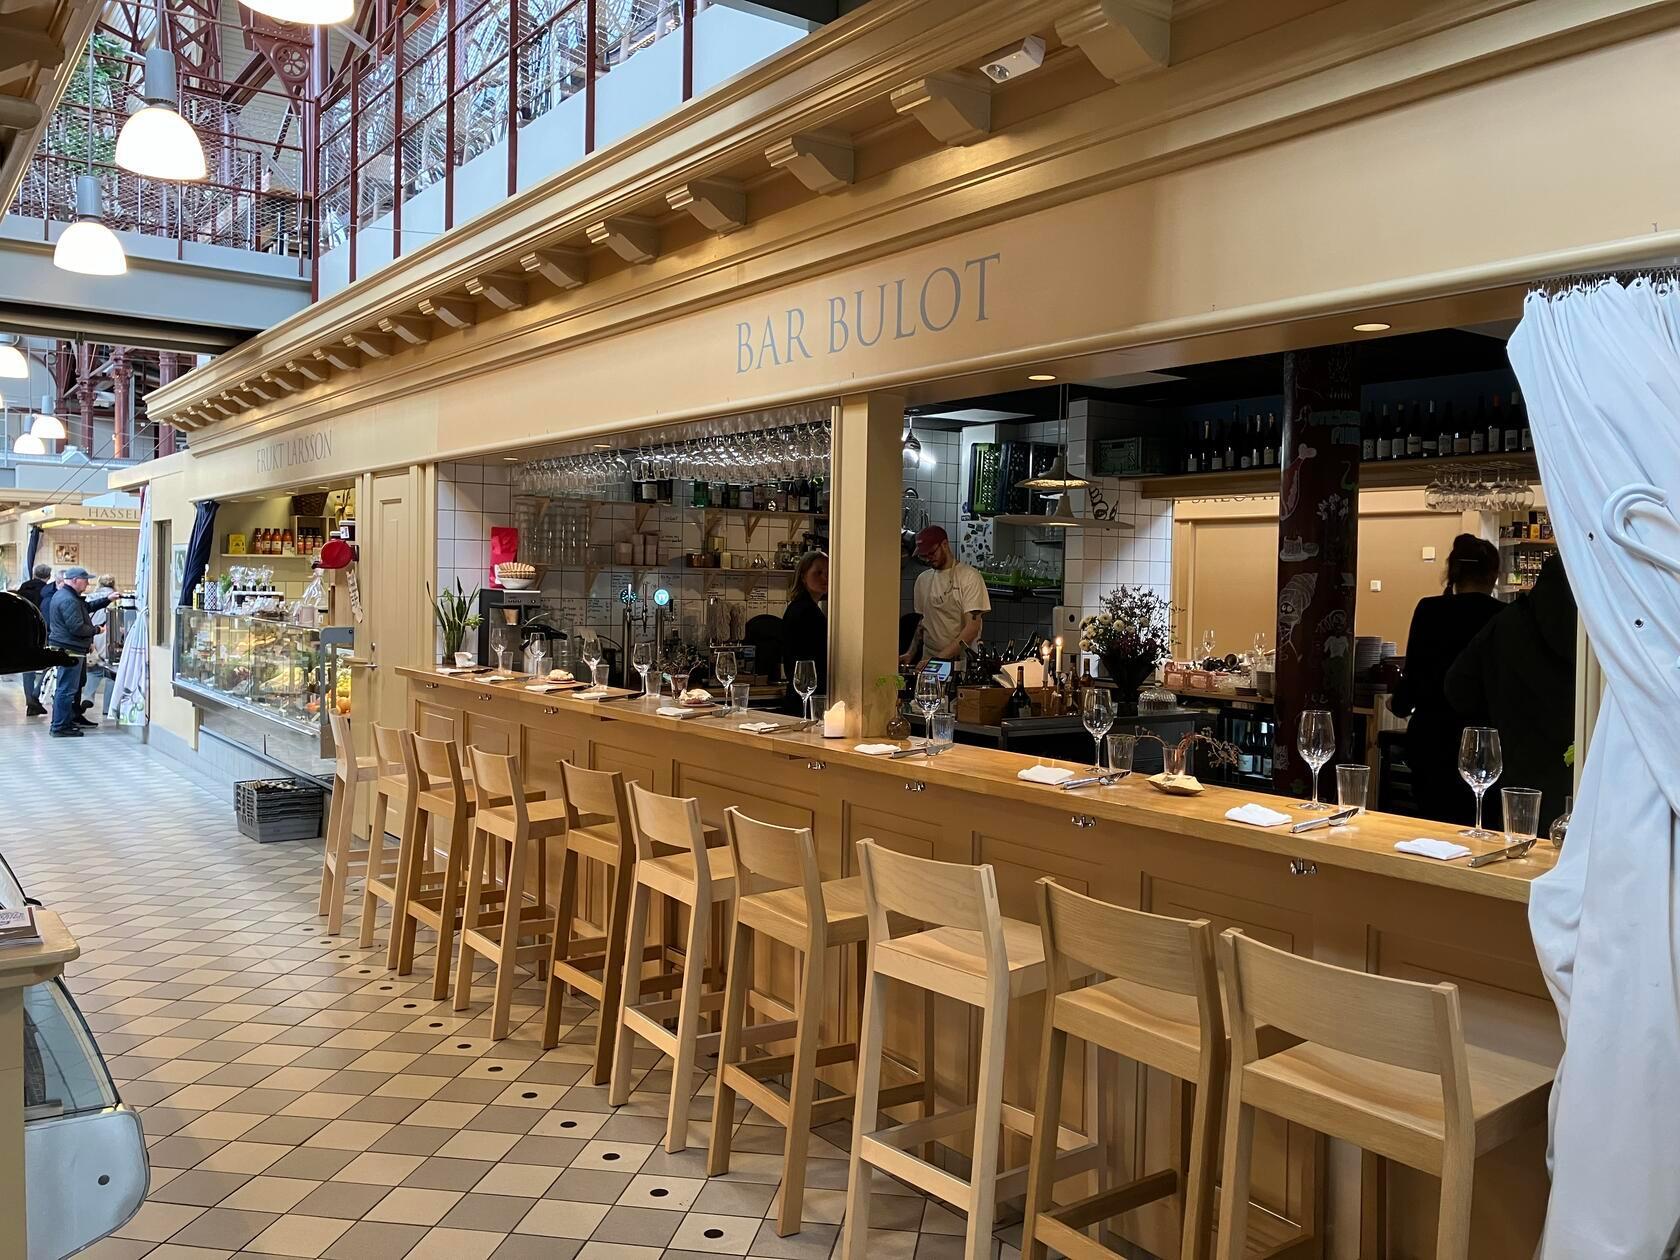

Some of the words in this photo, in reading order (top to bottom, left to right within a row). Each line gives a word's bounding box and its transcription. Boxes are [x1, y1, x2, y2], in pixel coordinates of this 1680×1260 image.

[736, 308, 813, 374] BAR
[827, 253, 1000, 354] BULOT
[256, 443, 284, 473] FRUKT
[287, 430, 332, 465] LARSSON
